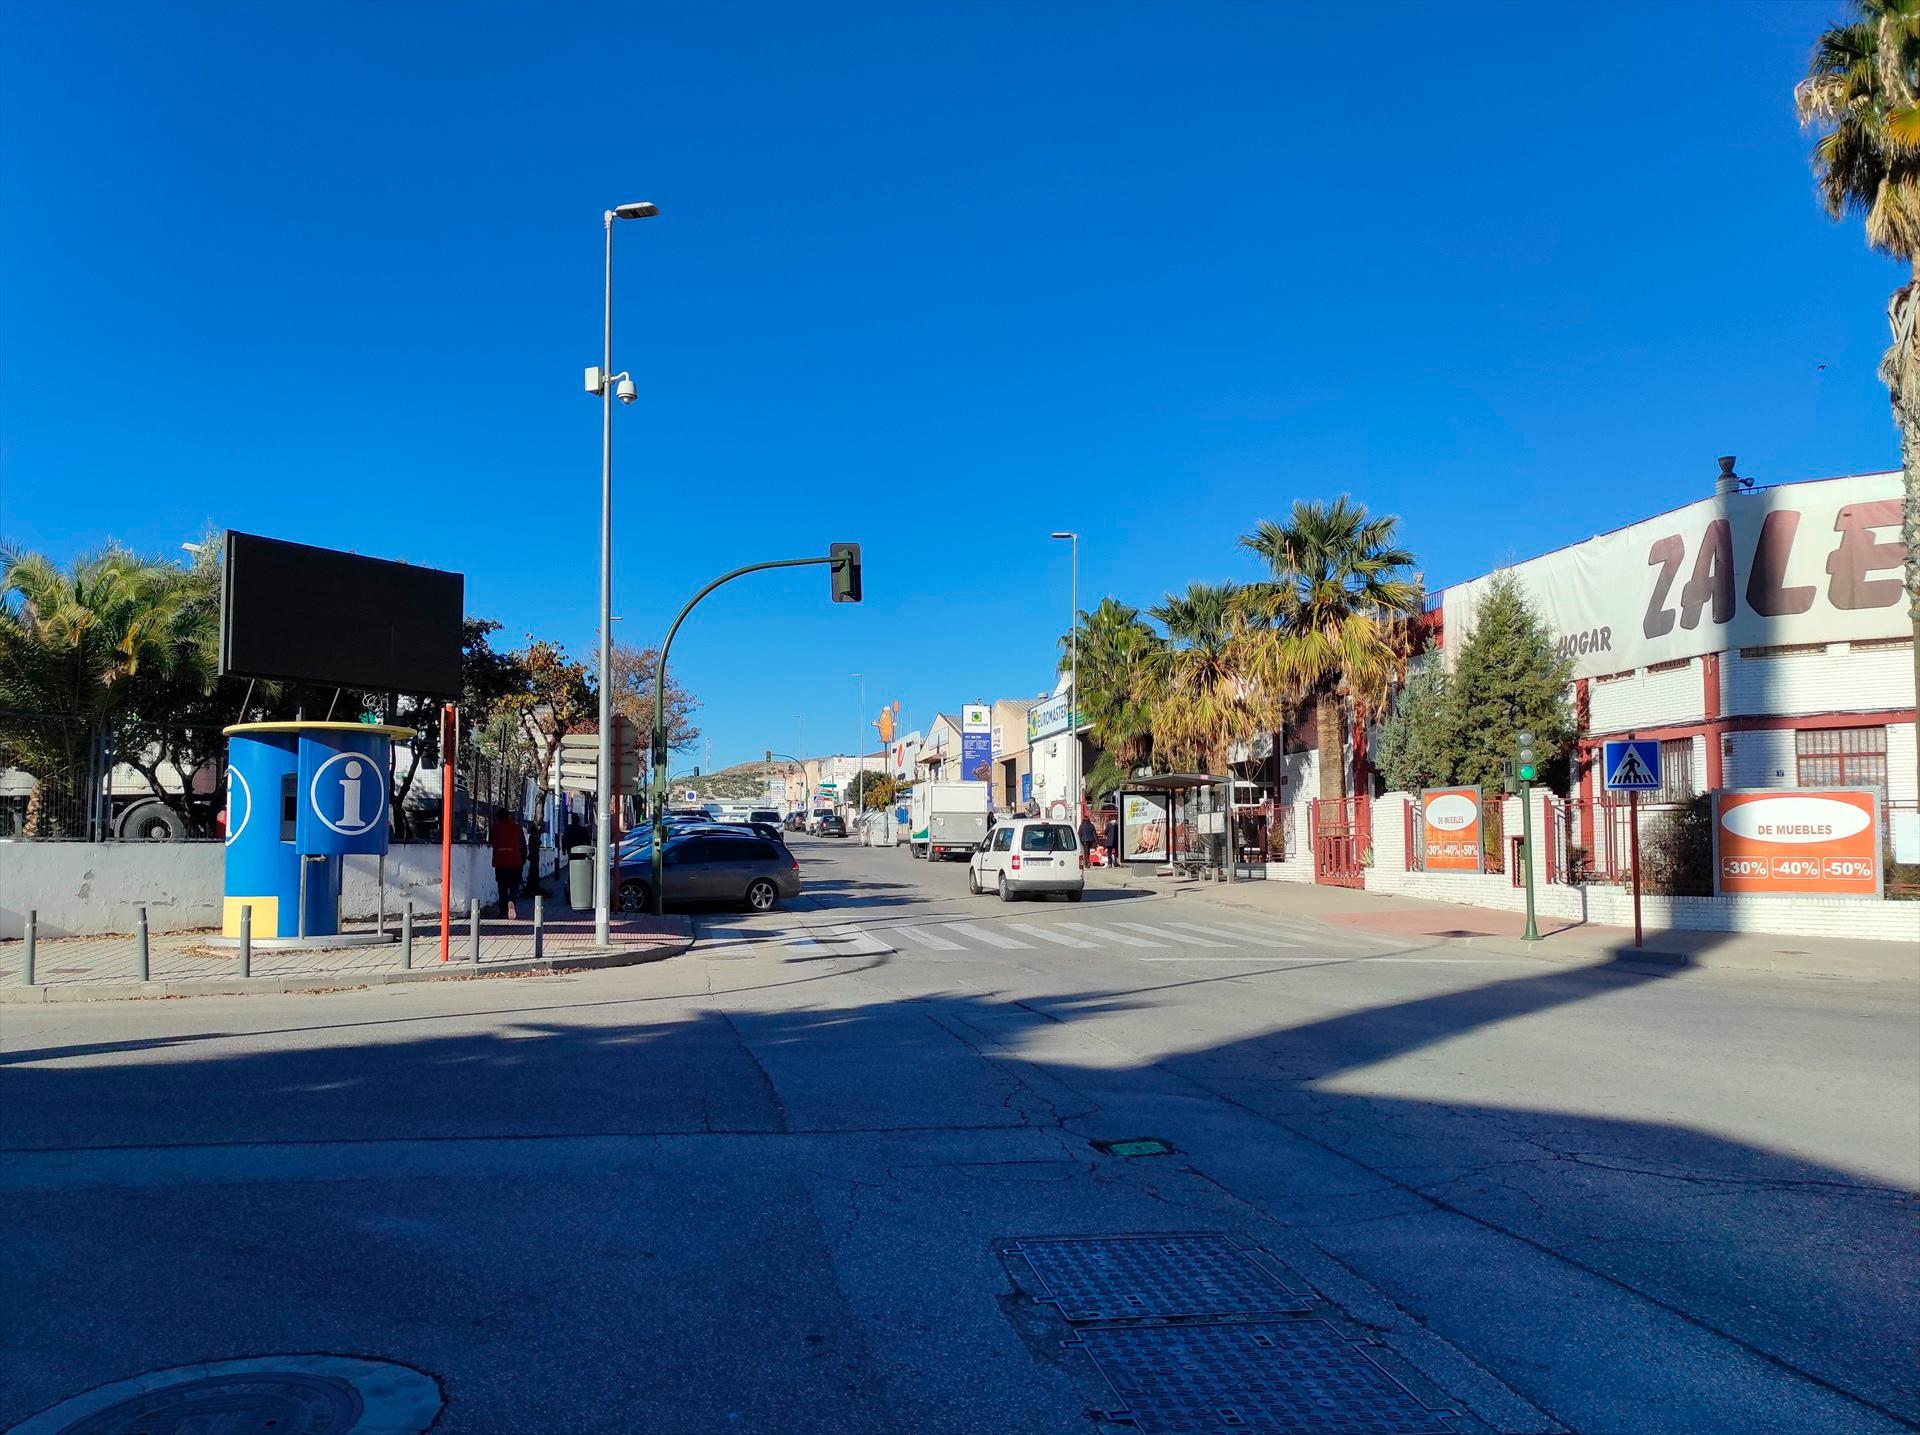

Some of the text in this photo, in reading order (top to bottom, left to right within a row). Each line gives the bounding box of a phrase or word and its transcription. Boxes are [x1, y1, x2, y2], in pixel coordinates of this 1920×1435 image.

[1556, 626, 1612, 661] HOGAR
[1037, 703, 1068, 728] EUROMASTER
[1757, 824, 1833, 835] DE MUEBLES
[1426, 844, 1478, 857] -30% -40% -50%
[1724, 861, 1871, 877] -30% -40% -50%
